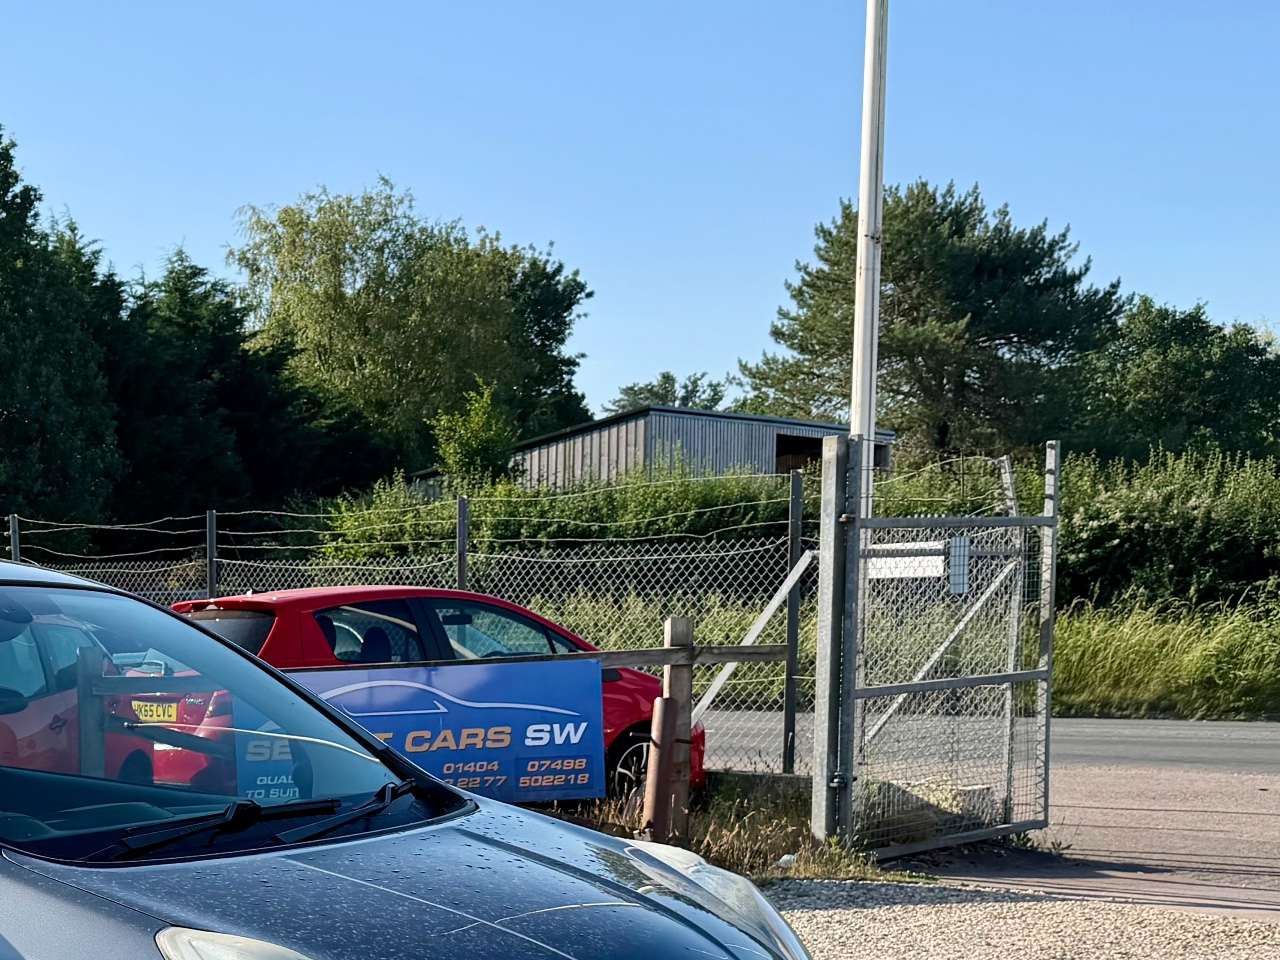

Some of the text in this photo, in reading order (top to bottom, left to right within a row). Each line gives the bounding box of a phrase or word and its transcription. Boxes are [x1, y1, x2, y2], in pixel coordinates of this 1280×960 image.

[156, 703, 173, 717] CVC
[404, 721, 588, 753] CARS SW
[443, 758, 587, 774] 01404 07498
[519, 773, 590, 787] 502218
[246, 789, 265, 799] TO
